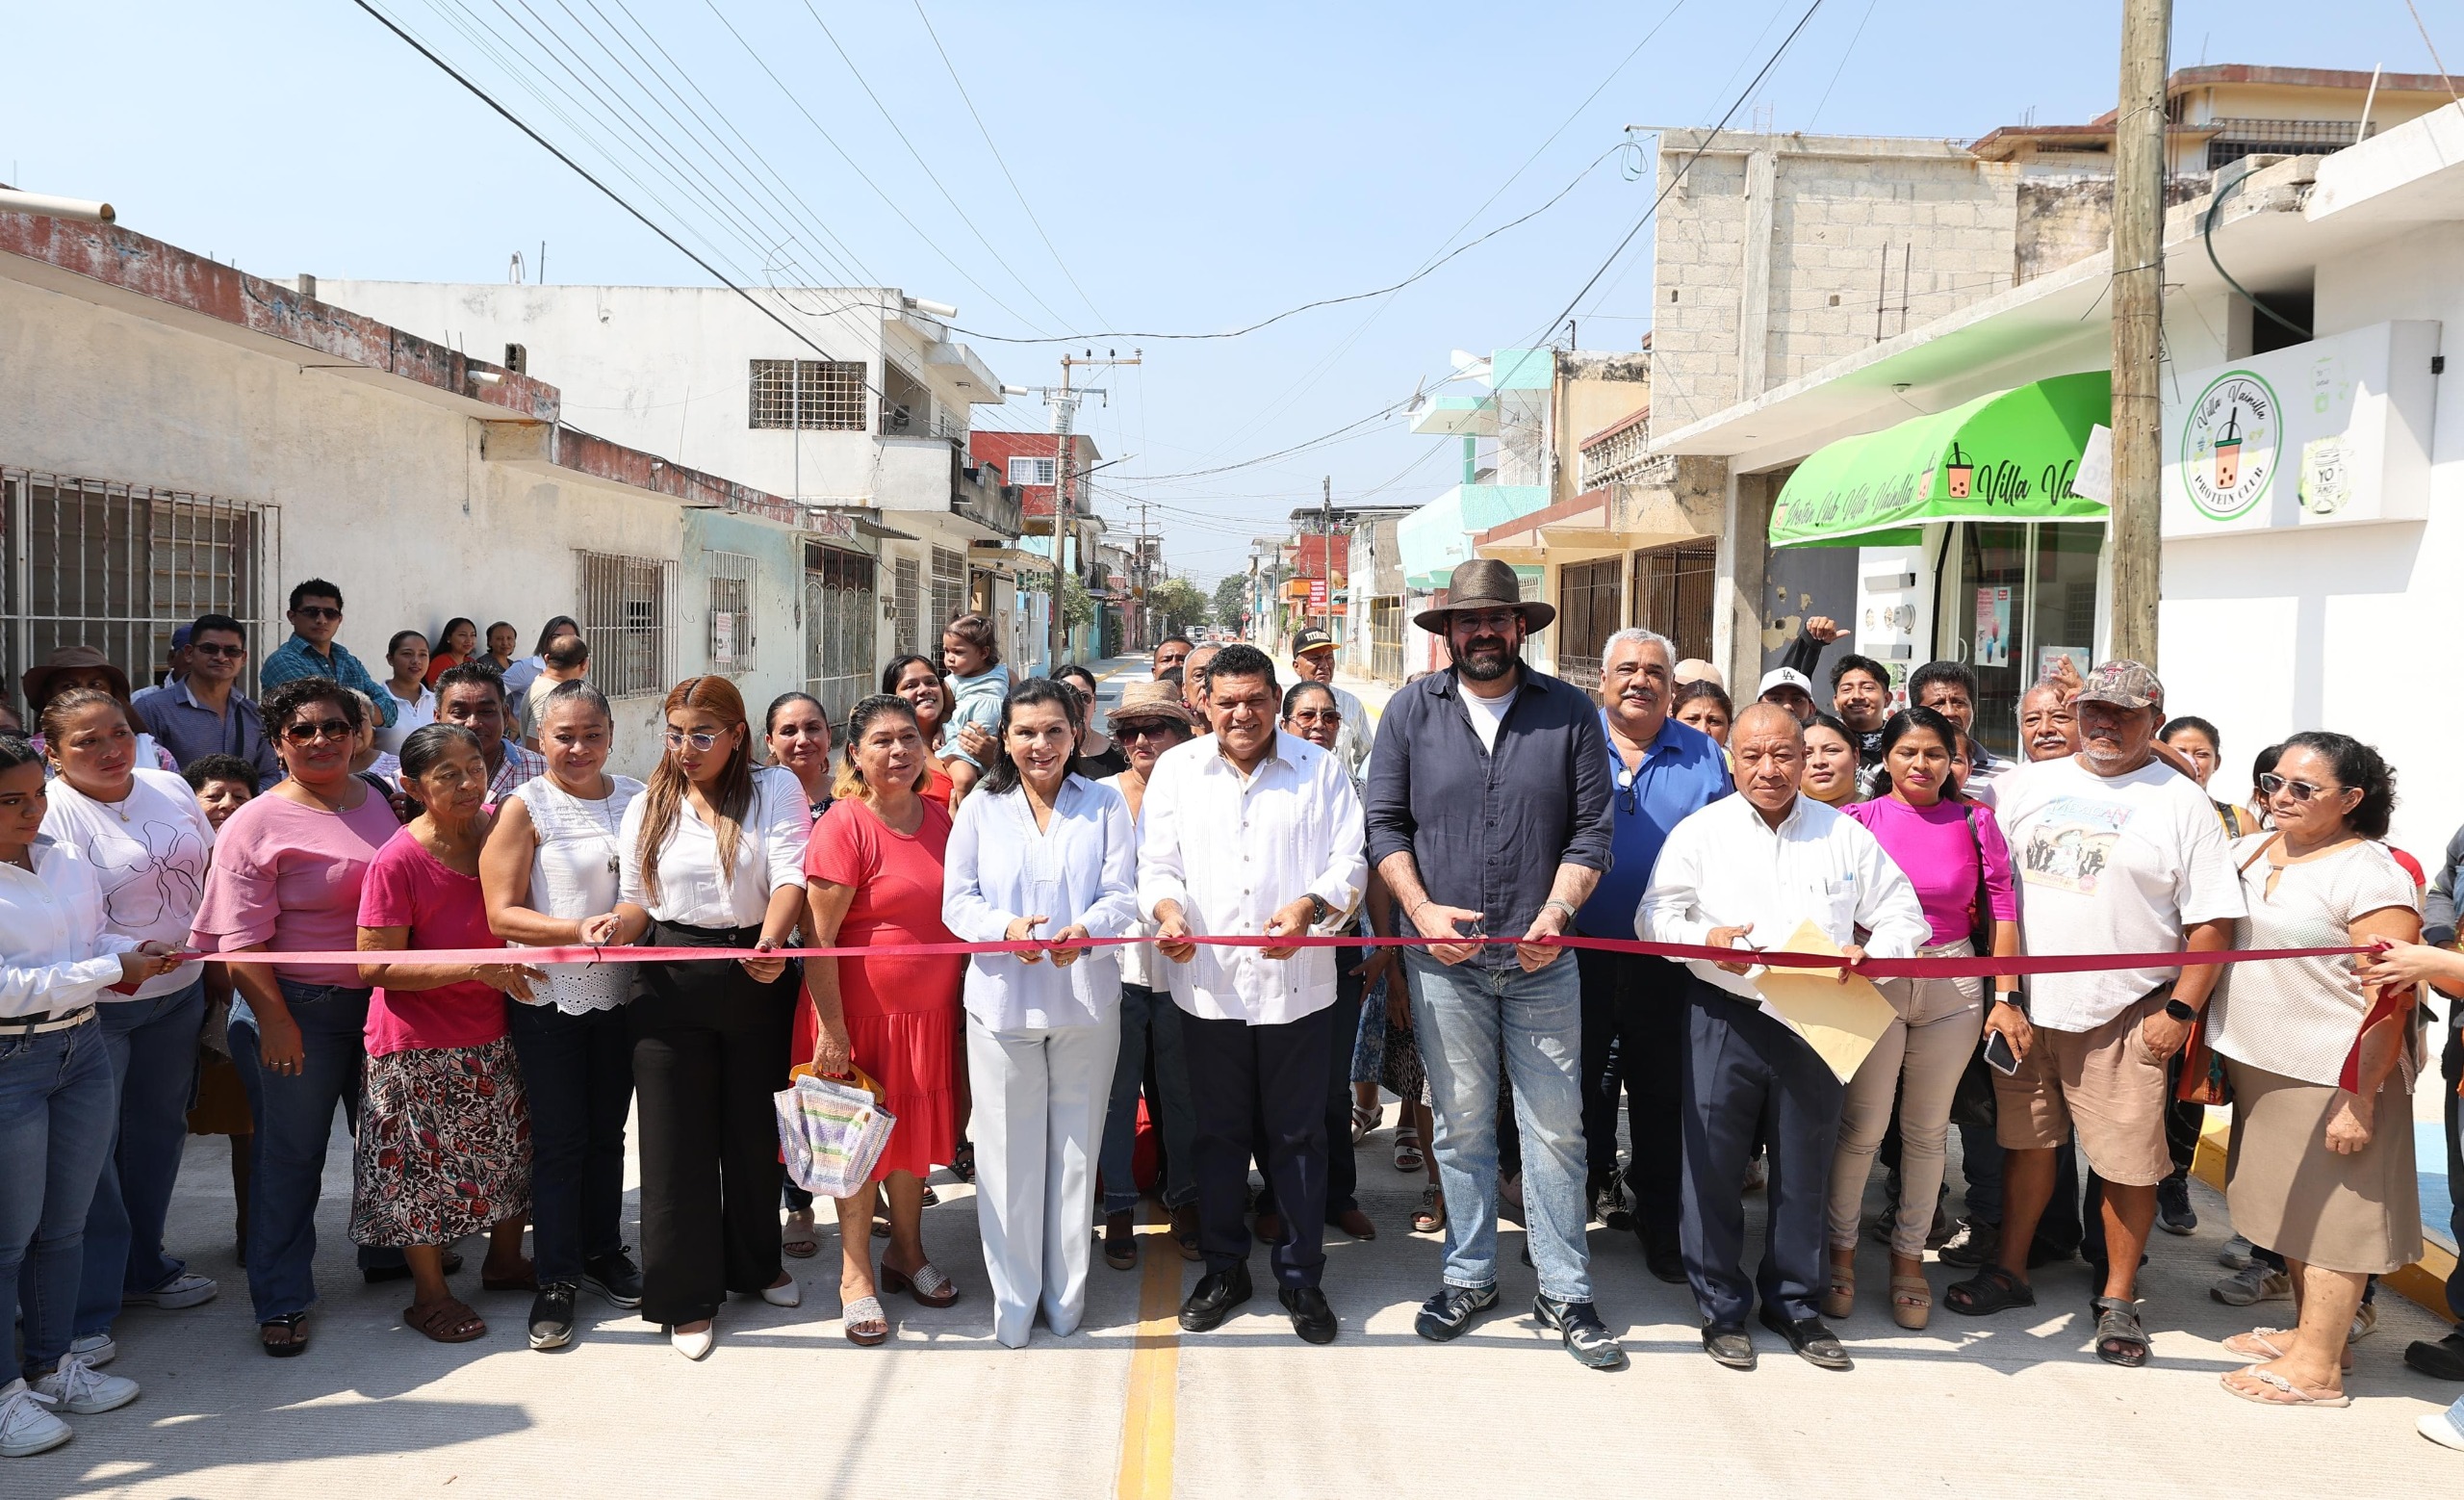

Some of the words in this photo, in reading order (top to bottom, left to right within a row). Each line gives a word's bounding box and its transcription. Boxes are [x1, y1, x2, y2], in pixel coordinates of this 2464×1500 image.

[2197, 397, 2222, 429] Villa
[2228, 381, 2267, 421] Vainilla
[1976, 459, 2032, 506] Villa
[2194, 475, 2235, 505] PROTEIN
[2238, 466, 2263, 500] CLUB
[2318, 467, 2334, 483] YO
[1842, 482, 1870, 522] Villa
[1872, 474, 1913, 515] Vainilla
[1782, 669, 1795, 681] LA
[2050, 799, 2132, 824] MEXICAN
